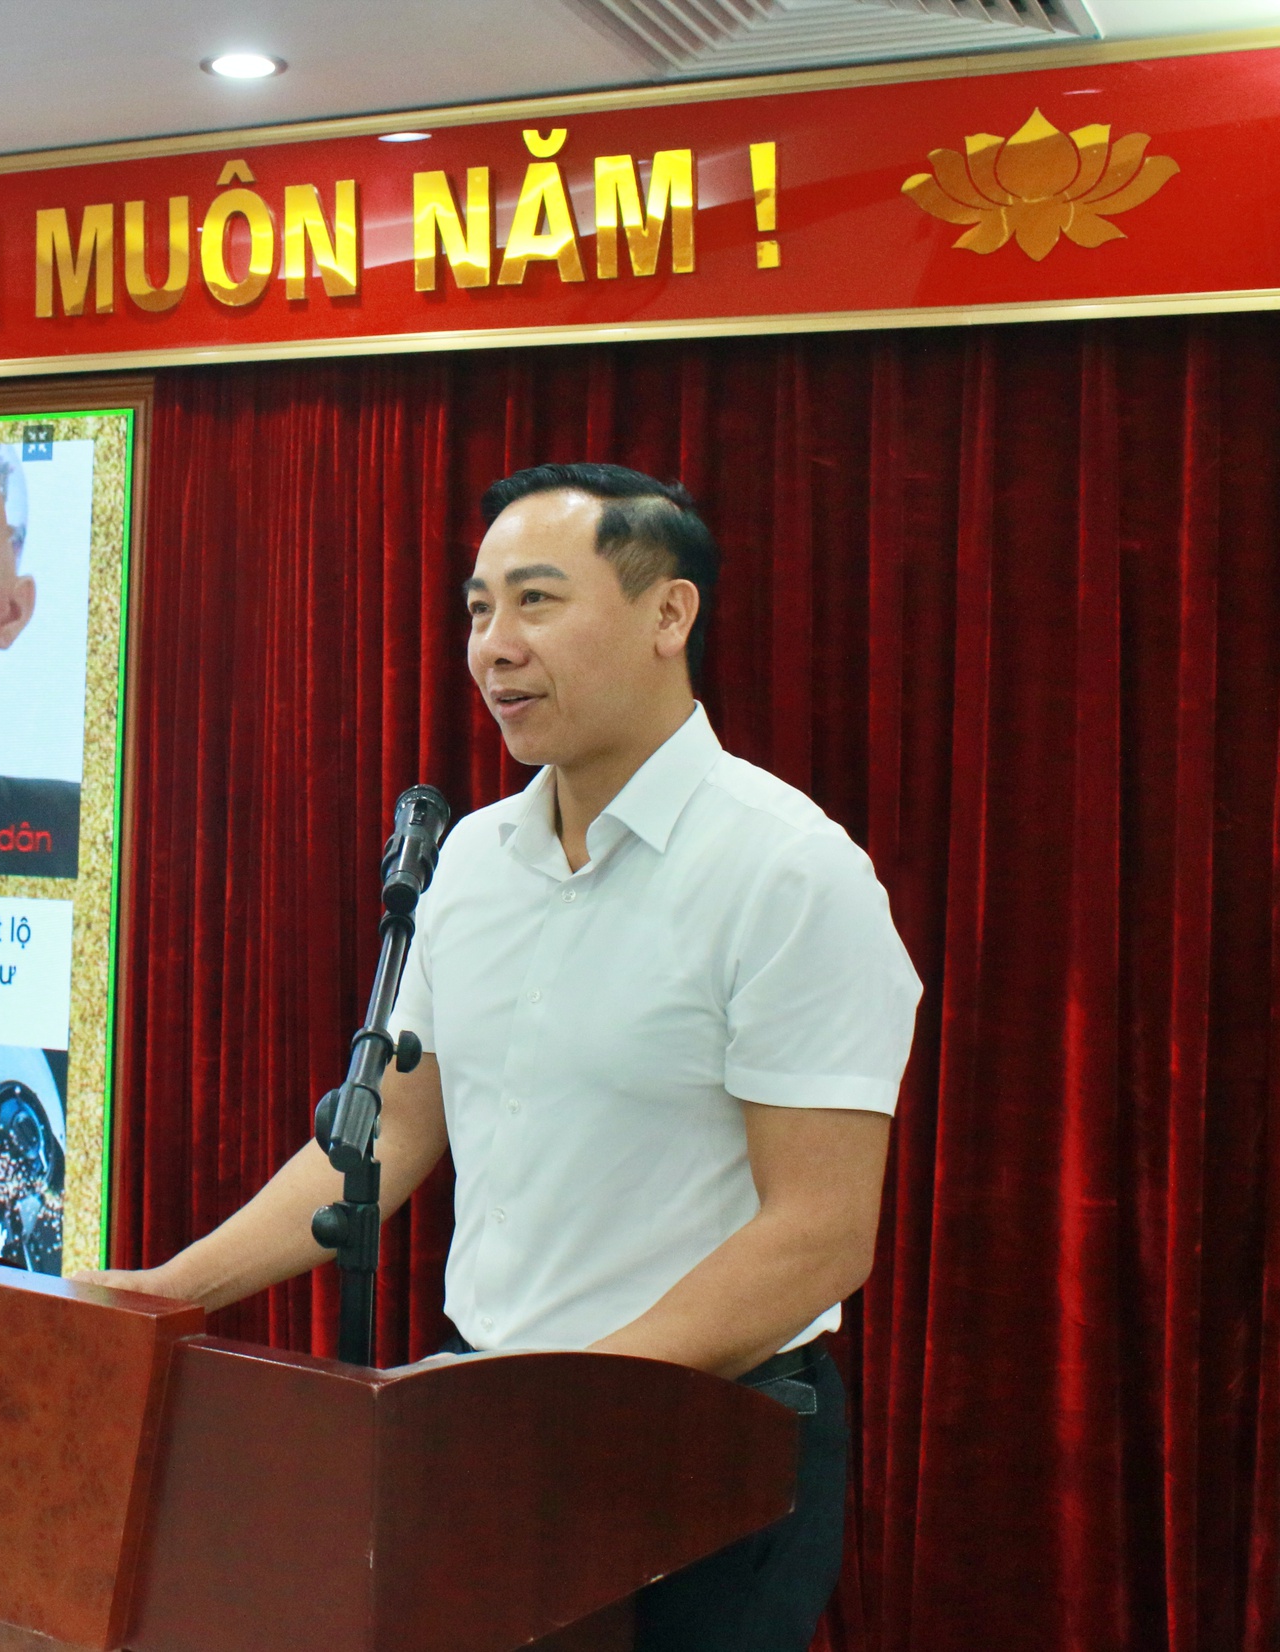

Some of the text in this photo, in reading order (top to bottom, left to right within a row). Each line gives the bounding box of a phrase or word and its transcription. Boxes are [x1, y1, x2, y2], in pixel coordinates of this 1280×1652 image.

[35, 158, 358, 317] MUÔN
[413, 128, 696, 293] NĂM
[749, 141, 781, 270] !
[10, 916, 31, 949] lộ
